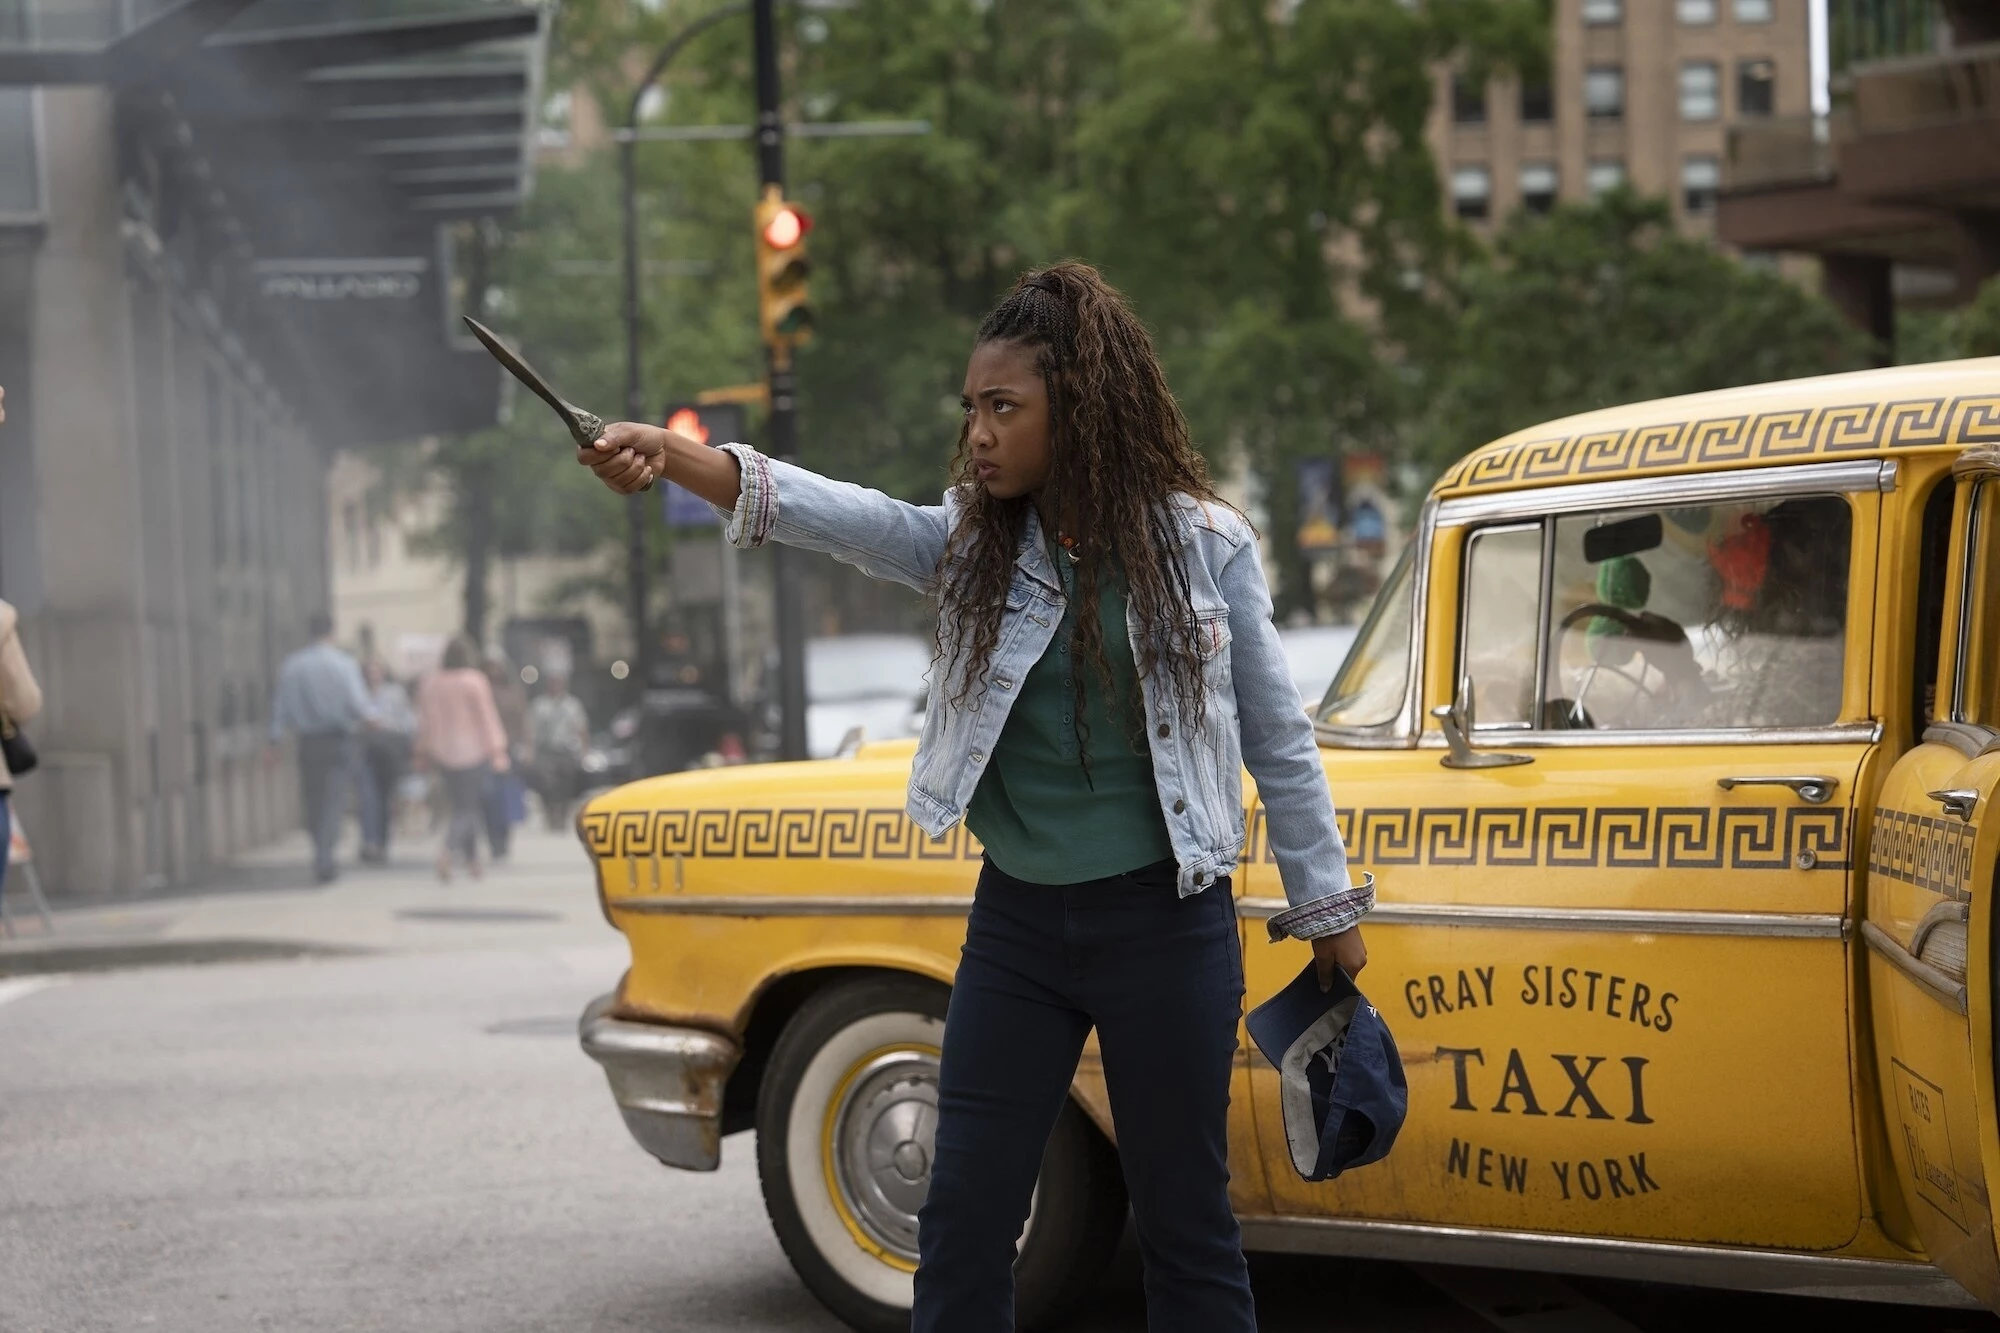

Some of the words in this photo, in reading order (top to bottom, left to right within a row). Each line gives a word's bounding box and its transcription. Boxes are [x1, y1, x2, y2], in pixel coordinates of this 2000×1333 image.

[1404, 965, 1495, 1020] GRAY
[1520, 964, 1680, 1033] SISTERS
[1433, 1045, 1656, 1125] TAXI
[1908, 1083, 1932, 1124] RATES
[1447, 1137, 1529, 1195] NEW
[1551, 1151, 1661, 1201] YORK
